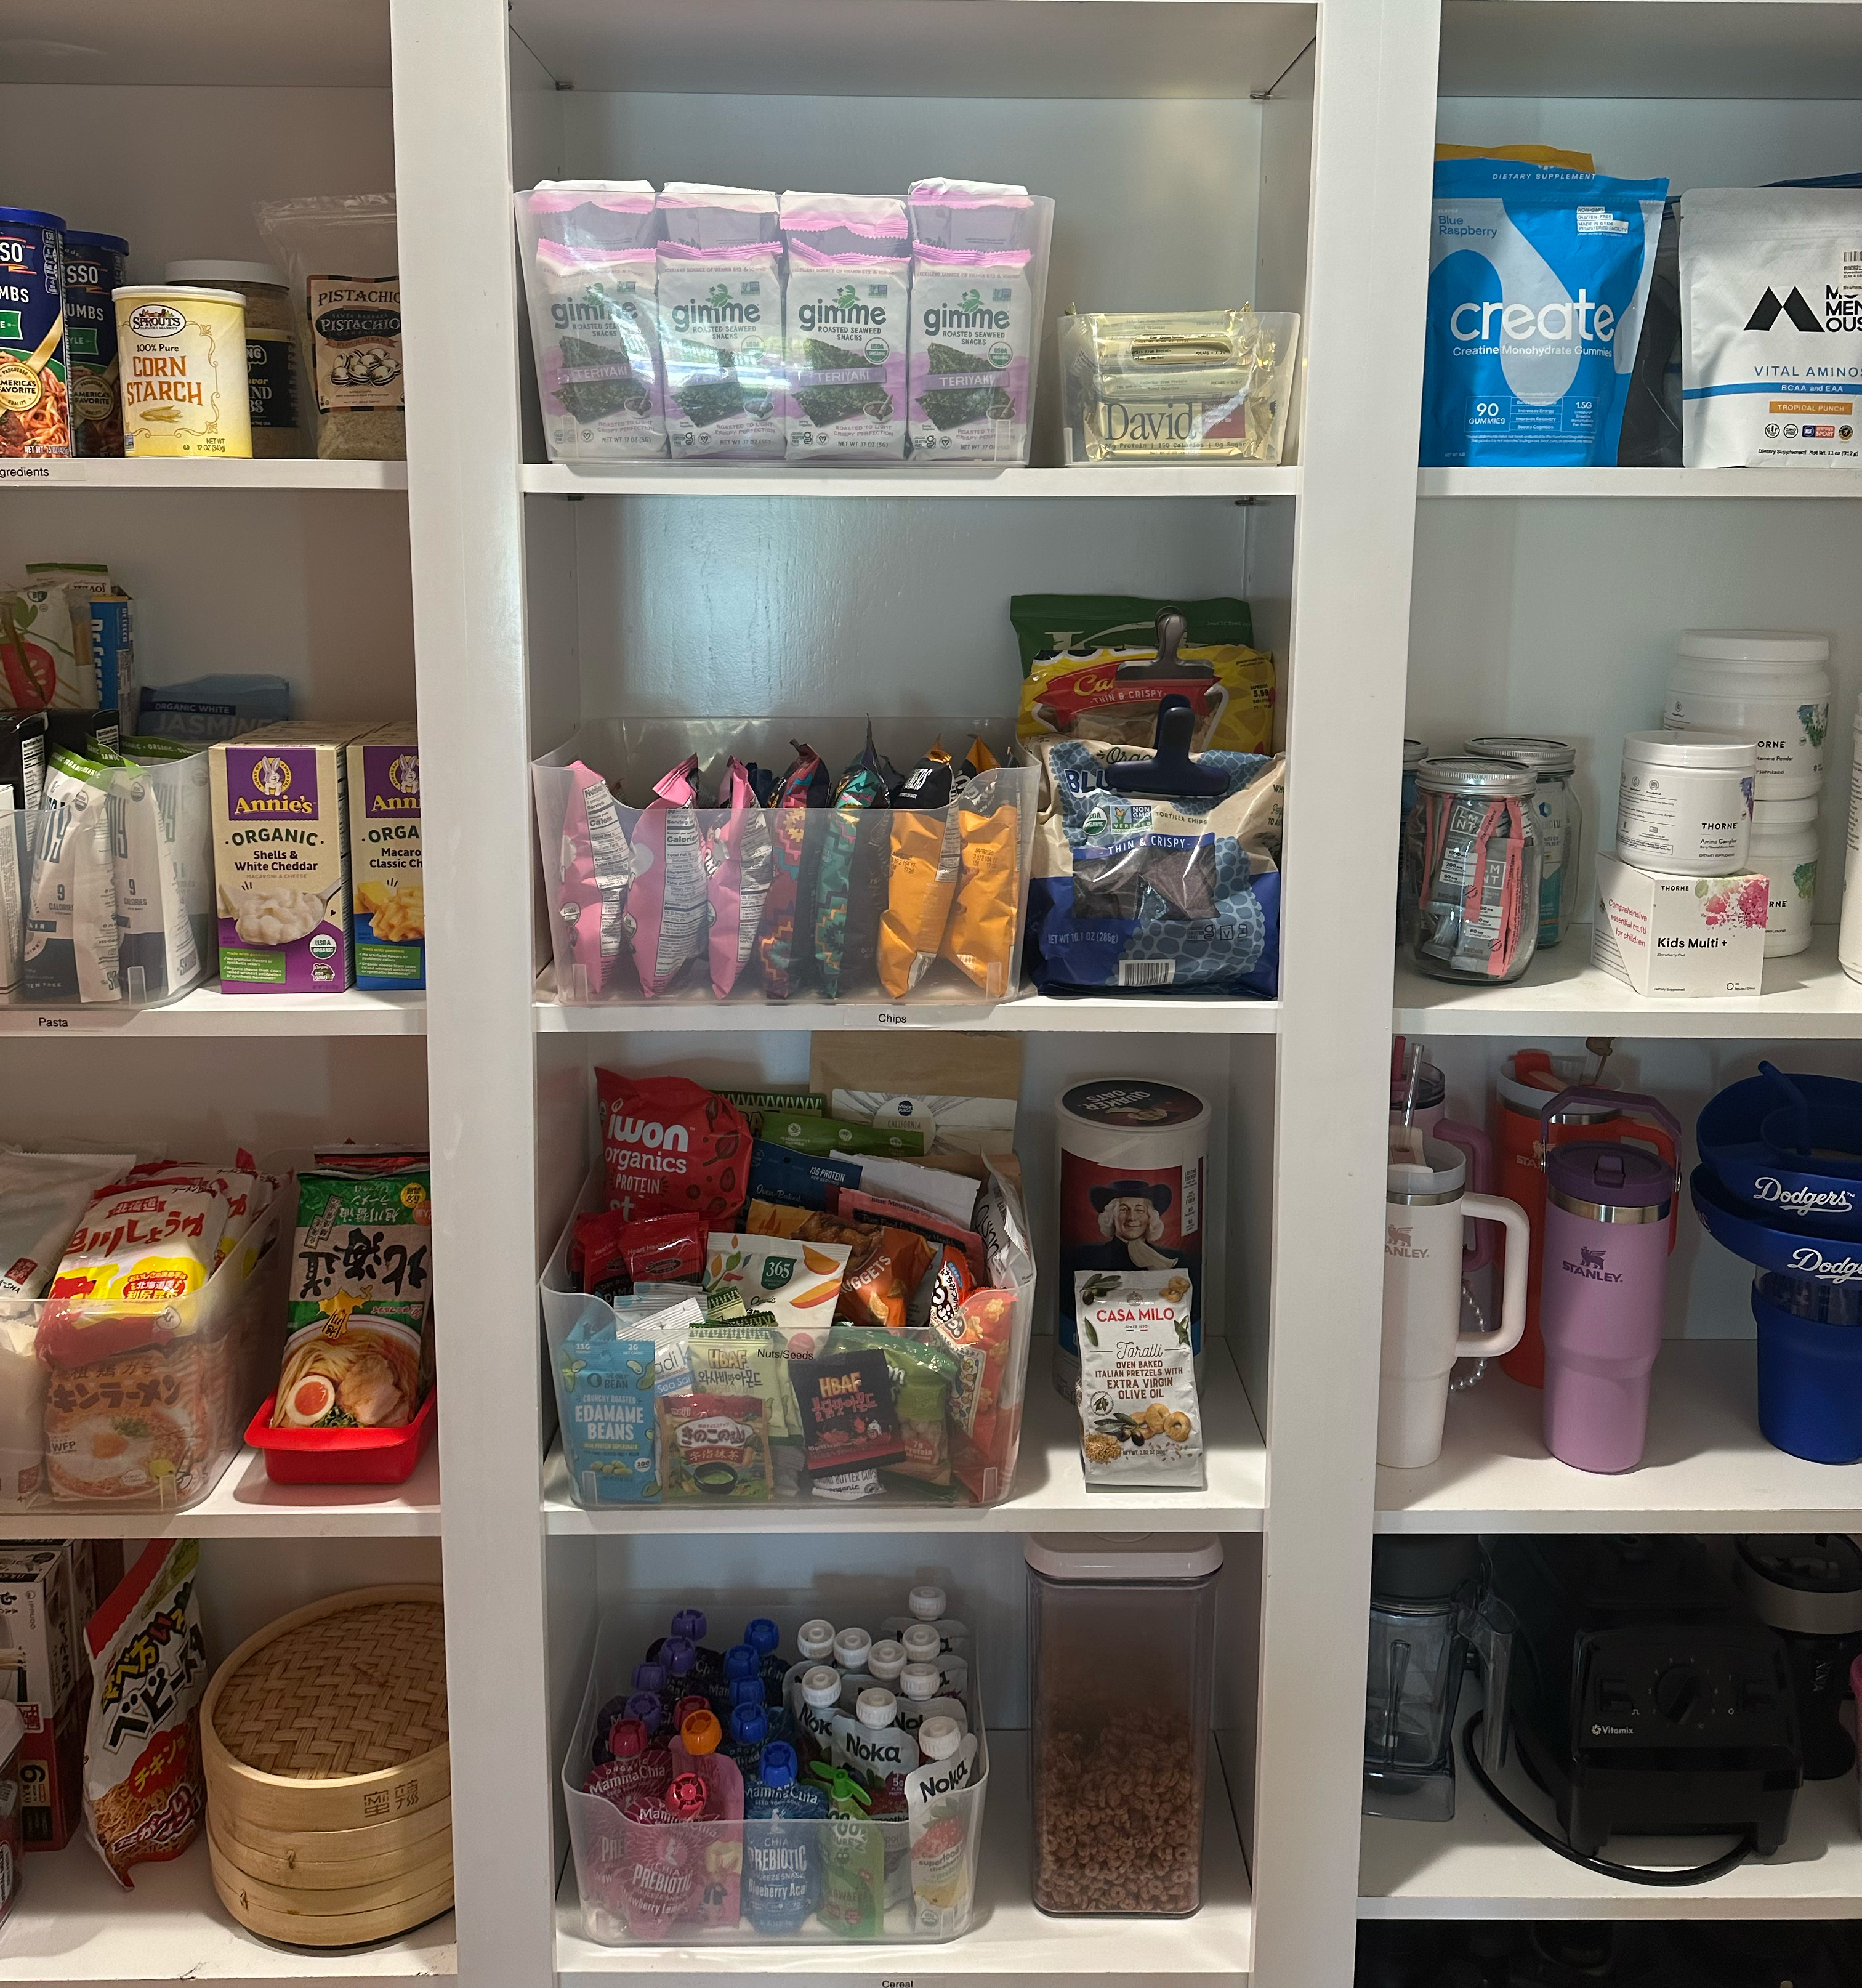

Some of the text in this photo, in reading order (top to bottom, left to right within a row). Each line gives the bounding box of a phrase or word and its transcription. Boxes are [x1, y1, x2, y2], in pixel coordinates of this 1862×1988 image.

[1438, 216, 1464, 225] Blue
[1438, 225, 1497, 239] Raspberry
[672, 298, 761, 333] gimme
[799, 298, 887, 332] gimme
[923, 302, 1010, 336] gimme
[1450, 288, 1615, 341] create
[132, 315, 181, 329] SPROUTS
[818, 326, 848, 334] ROASTED
[975, 331, 1006, 339] SEAWEED
[837, 334, 863, 342] SNACKS
[136, 344, 180, 353] 100% Pure
[1453, 345, 1613, 358] Creatine Monohydrate Gummies
[132, 355, 187, 378] CORN
[1754, 366, 1862, 378] VITAL AMINO
[815, 371, 869, 383] TERIYAKI
[939, 374, 995, 387] TERIYAKI
[127, 381, 204, 406] STARCH
[1781, 384, 1844, 393] BCAA and EAA
[74, 397, 110, 405] FAVORITE
[1575, 402, 1592, 410] 1.5G
[1818, 404, 1845, 412] PUNCH
[1476, 403, 1499, 417] 90
[1104, 402, 1197, 441] David
[0, 466, 49, 479] gredients
[1092, 693, 1116, 703] THIN
[1128, 689, 1163, 700] CRISPY
[1253, 687, 1270, 697] 5.99
[155, 703, 196, 712] ORGANIC
[235, 794, 313, 815] Annie's
[1155, 810, 1209, 825] TORTILLA CHIPS
[1113, 822, 1152, 830] VERIFIED
[232, 828, 319, 846] ORGANIC
[1108, 835, 1186, 855] THIN & CRISPY
[253, 850, 299, 860] Shells &
[234, 861, 318, 871] White Cheddar
[369, 859, 408, 868] Classic
[57, 884, 65, 901] 9
[1608, 898, 1648, 923] Comprehensive
[1610, 913, 1648, 935] essential multi
[1071, 933, 1085, 943] 10.1
[1086, 932, 1095, 942] OZ
[1615, 927, 1646, 948] for children
[1657, 937, 1728, 949] Kids Multi +
[38, 1017, 69, 1028] Pasta
[877, 1013, 908, 1025] Chips
[887, 1120, 922, 1130] CALIFORNIA
[607, 1113, 690, 1154] iwon
[604, 1146, 688, 1174] organics
[820, 1168, 845, 1183] PROTEIN
[615, 1173, 661, 1195] PROTEIN
[756, 1183, 803, 1203] Oven-Baked
[1752, 1176, 1853, 1217] Dodgers
[887, 1198, 921, 1215] Mountain
[299, 1227, 427, 1299] 北海道
[765, 1260, 791, 1279] 365
[1562, 1261, 1624, 1283] STANLEY
[1096, 1307, 1175, 1323] CASA MILO
[757, 1349, 814, 1360] Nuts/Seeds
[1116, 1341, 1164, 1360] Taralli
[707, 1348, 748, 1370] HBAF
[1116, 1360, 1164, 1369] OVEN BAKED
[698, 1369, 764, 1388] 와사비맛아몬드
[1095, 1367, 1183, 1378] ITALIAN PRETZELS WITH
[605, 1378, 629, 1389] BEAN
[657, 1382, 675, 1394] Sea
[818, 1371, 862, 1399] HBAF
[1106, 1377, 1174, 1390] EXTRA VIRGIN
[49, 1373, 183, 1414] キンラーメン
[610, 1395, 637, 1405] ROASTED
[1118, 1388, 1165, 1400] OLIVE OIL
[574, 1404, 645, 1424] EDAMAME
[587, 1423, 634, 1442] BEANS
[52, 1440, 76, 1452] WFP
[835, 1471, 860, 1483] BUTTER
[1601, 1726, 1634, 1734] Vitamix
[845, 1732, 902, 1764] Noka
[919, 1758, 969, 1803] Noka
[763, 1836, 790, 1847] CHIA
[747, 1845, 808, 1872] PREBIOTIC
[632, 1863, 693, 1894] PREBIOTIC
